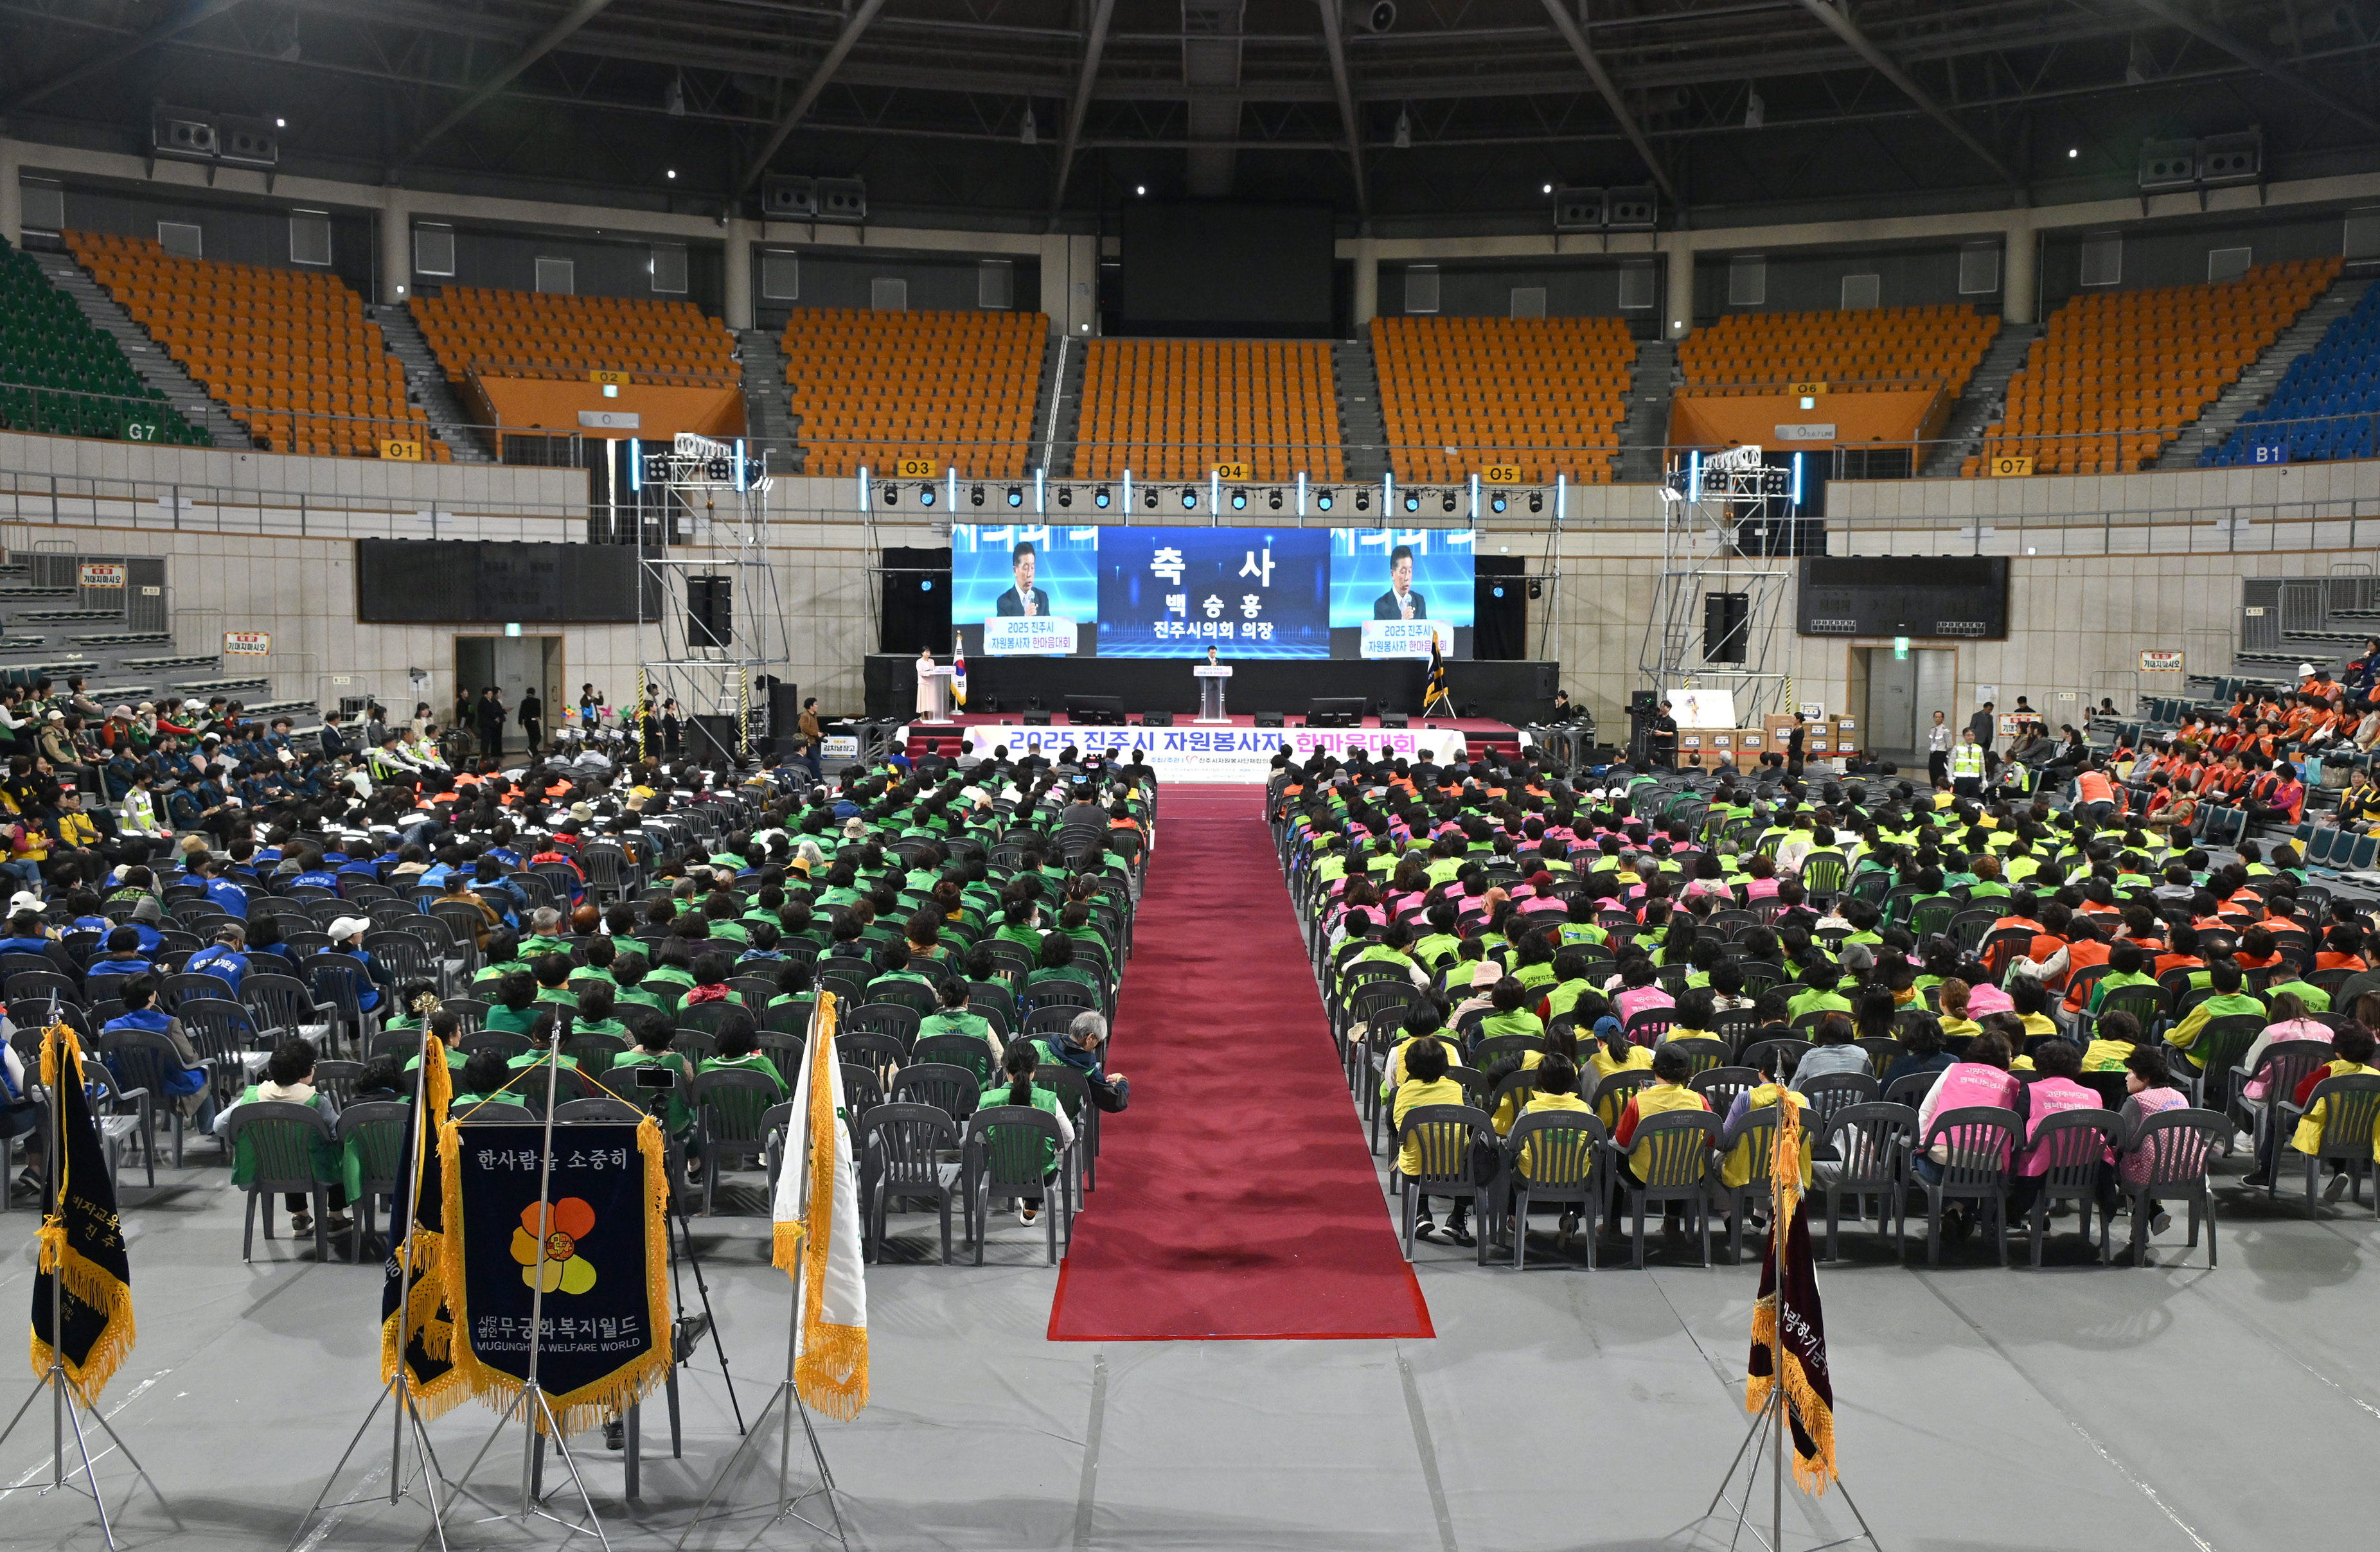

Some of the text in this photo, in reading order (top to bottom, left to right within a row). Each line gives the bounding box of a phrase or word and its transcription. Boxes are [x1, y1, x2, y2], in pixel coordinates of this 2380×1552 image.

[129, 423, 155, 441] G7
[2257, 446, 2278, 462] B1
[1150, 547, 1275, 587] 축 사
[84, 575, 121, 584] 기대지마시오
[1166, 594, 1186, 617] 백
[1203, 594, 1225, 618] 승
[1008, 621, 1054, 633] 2025 진주시
[1153, 621, 1274, 640] 진주시의회 의장
[1385, 625, 1431, 637] 2025 진주시
[228, 642, 266, 651] 기대지마시오
[991, 637, 1070, 649] 자원봉사자 한마음대회
[1369, 640, 1446, 653] 자원봉사자 한마음회
[2144, 660, 2180, 668] 기대지마시오
[1009, 732, 1416, 754] 2025 진주시 자원봉사자 한마음대회
[2046, 1090, 2089, 1100] 고향주부모임
[567, 1148, 627, 1170] 소중히
[478, 1316, 497, 1327] 사단
[499, 1315, 639, 1339] 무궁화복지월드
[478, 1327, 497, 1338] 법인
[548, 1343, 598, 1352] WELFARE
[601, 1337, 640, 1352] WORLD
